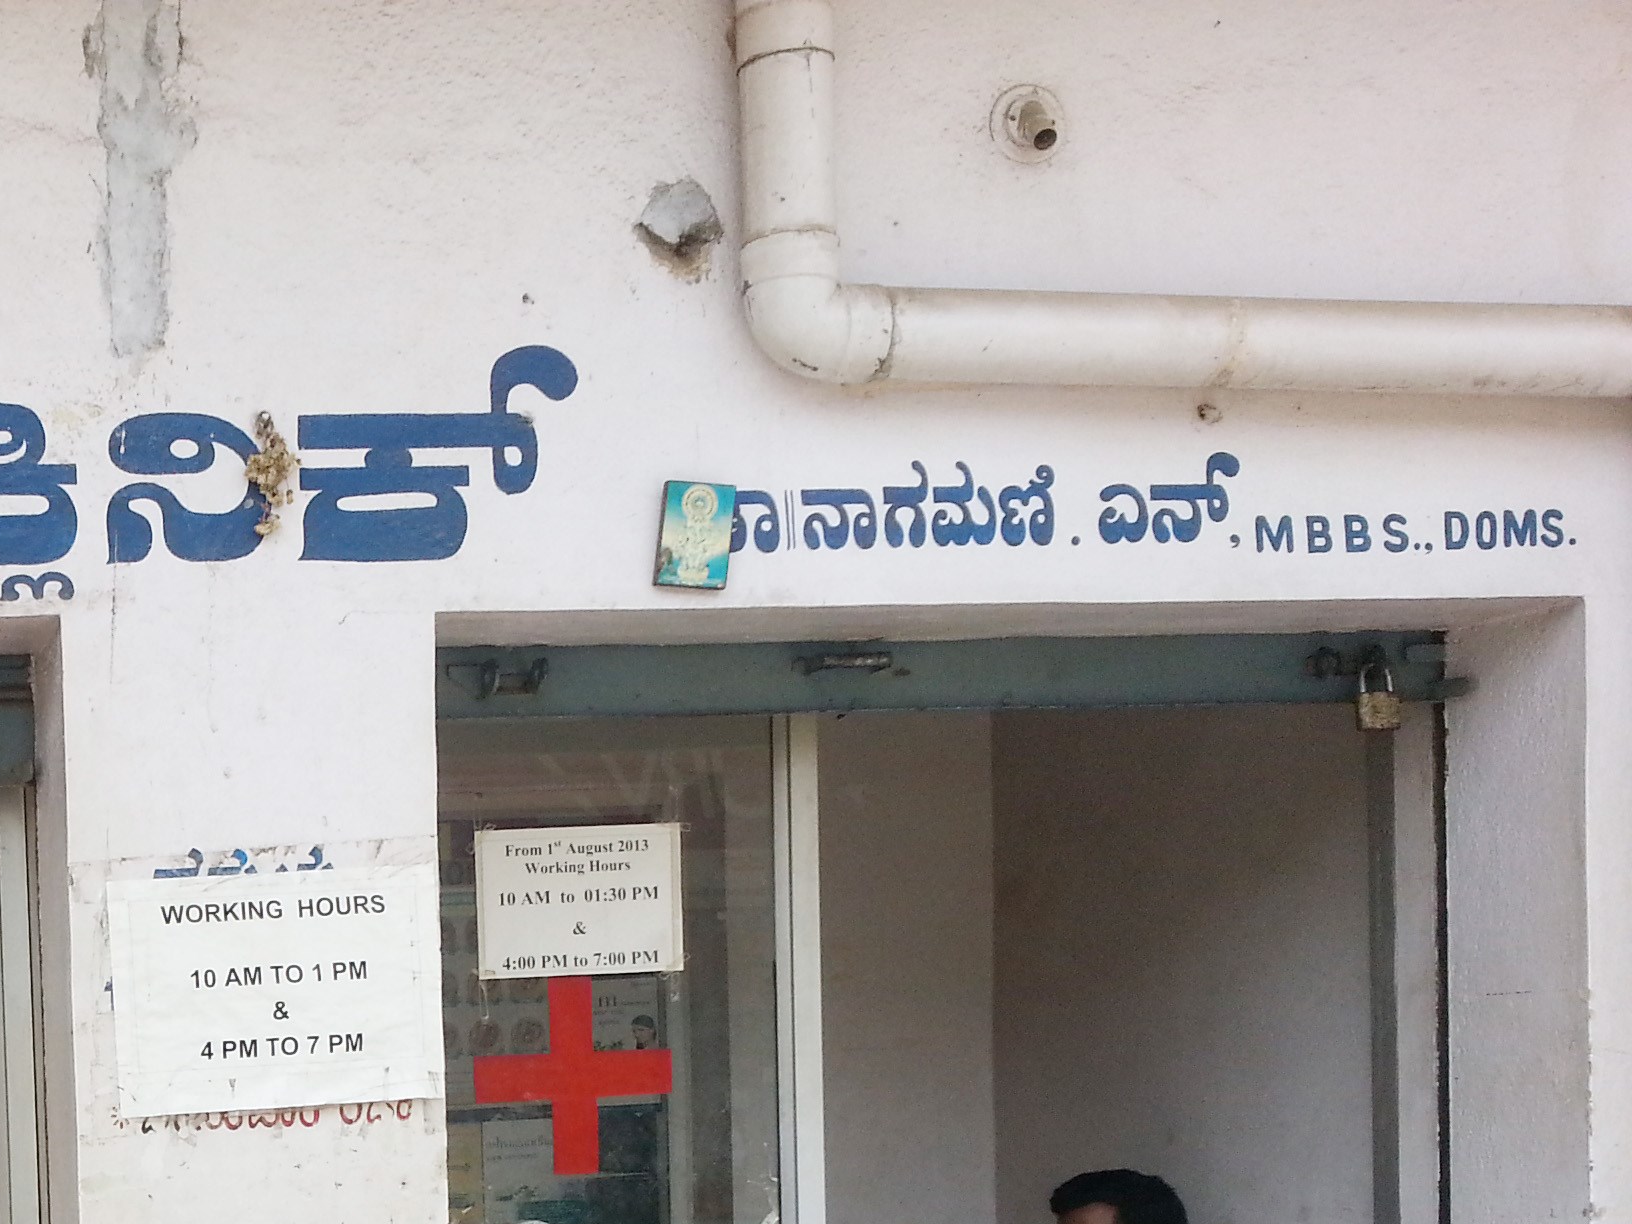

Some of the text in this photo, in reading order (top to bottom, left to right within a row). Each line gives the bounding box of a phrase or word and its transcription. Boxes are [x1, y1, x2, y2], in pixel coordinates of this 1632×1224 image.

[1444, 508, 1577, 551] DOMS.
[504, 843, 543, 858] From
[566, 840, 613, 856] August
[617, 838, 650, 853] 2013
[524, 858, 632, 876] Working Hours
[498, 884, 660, 908] 10 AM to 01:30 PM
[160, 894, 385, 925] WORKING HOURS
[571, 919, 588, 937] &
[500, 948, 660, 972] 4:00 PM to 7:00 PM
[190, 960, 367, 989] 10 AM TO 1 PM
[273, 1001, 290, 1020] &
[200, 1033, 363, 1060] 4 PM TO 7 PM
